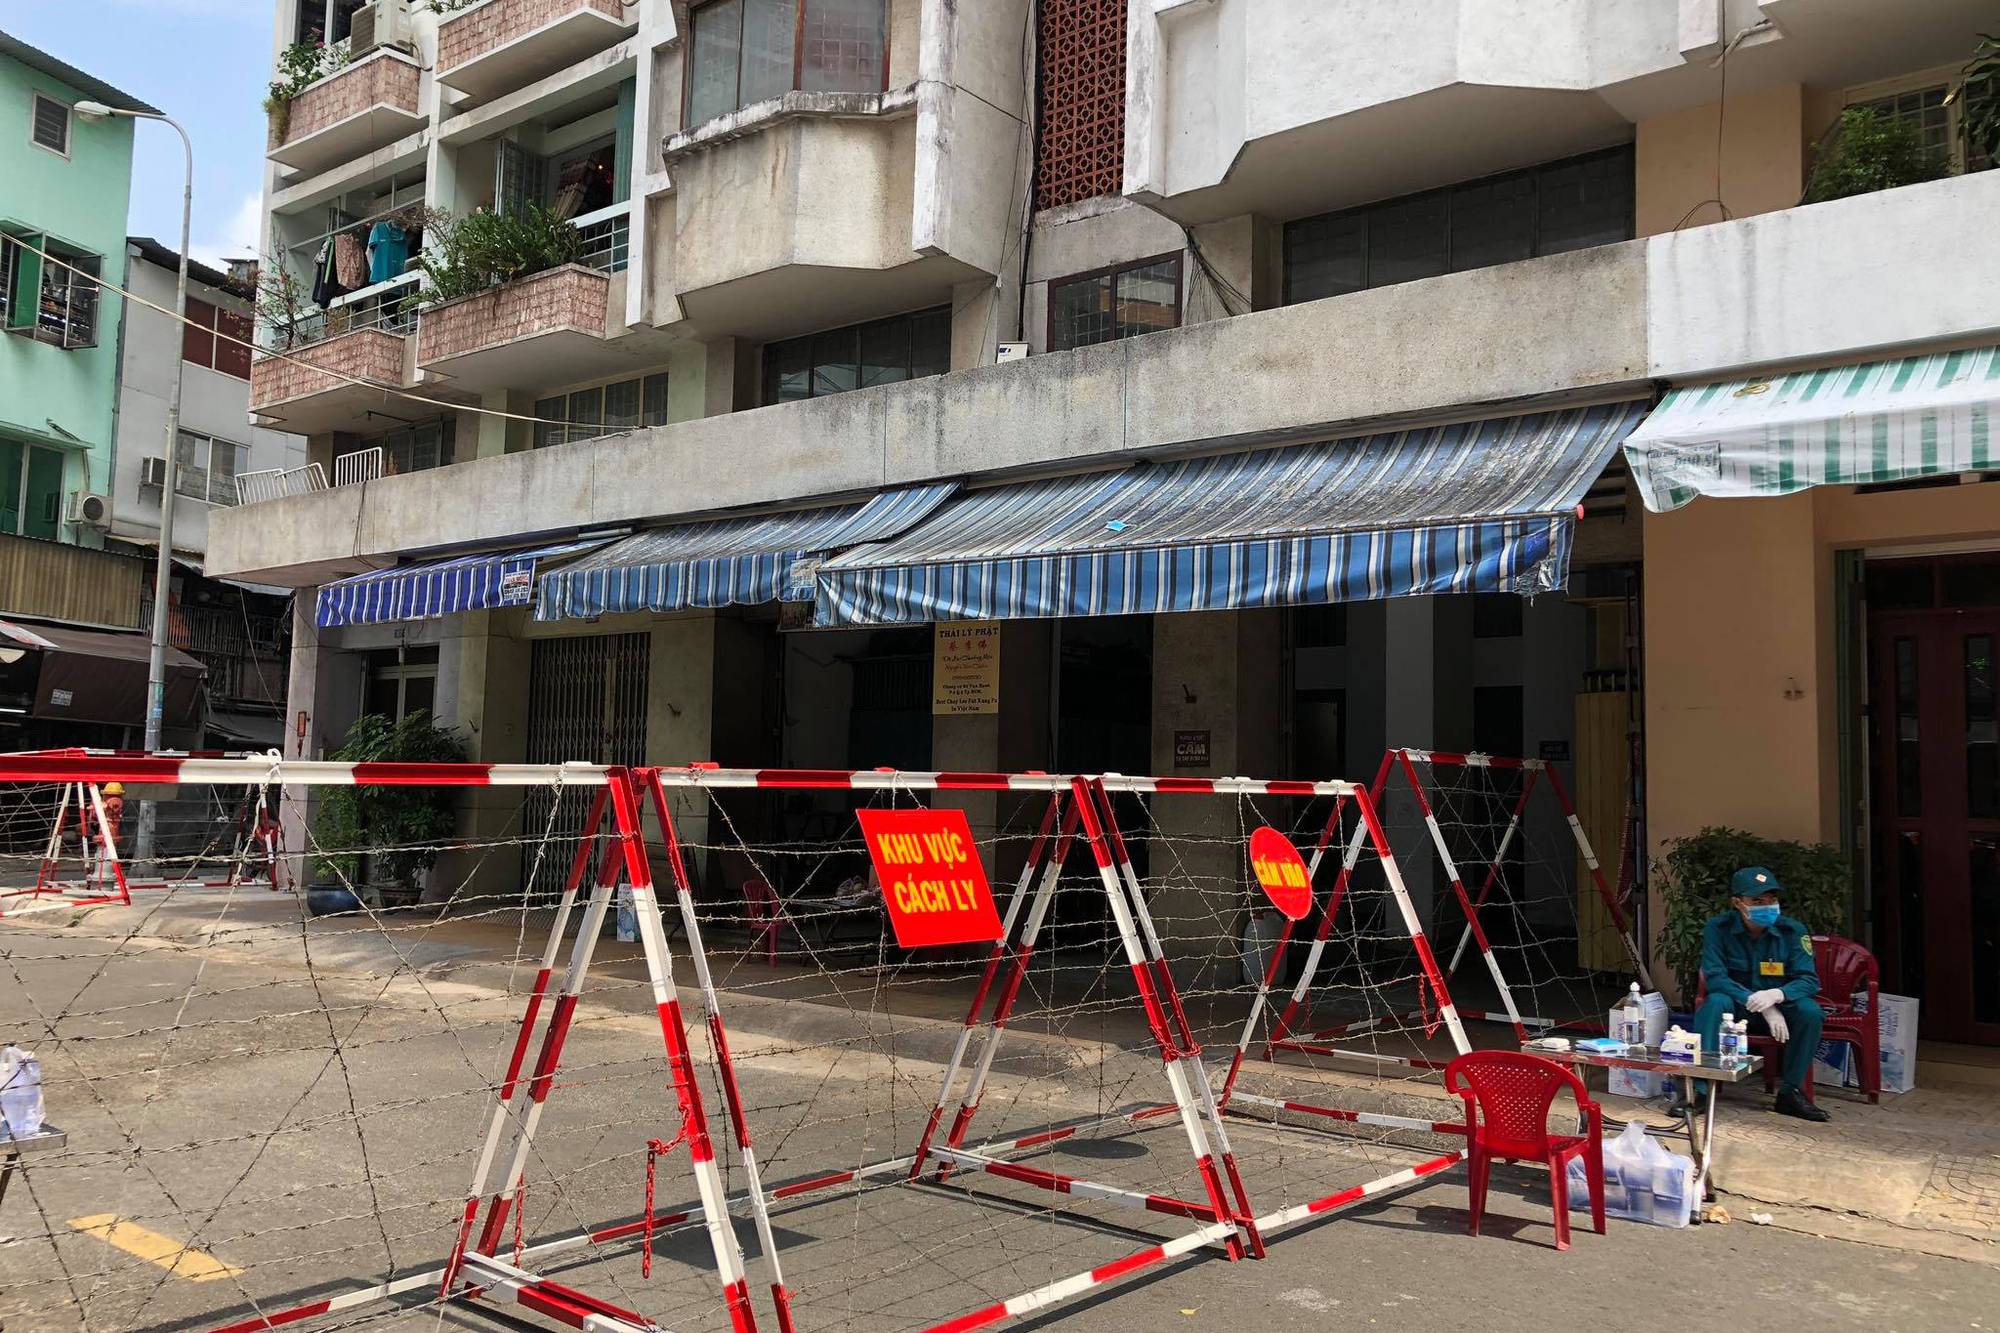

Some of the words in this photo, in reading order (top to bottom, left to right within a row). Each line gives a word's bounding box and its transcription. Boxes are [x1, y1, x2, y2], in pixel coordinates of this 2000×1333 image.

[1177, 741, 1206, 755] CẤM
[876, 833, 924, 865] KHU
[923, 827, 968, 870] VỰC
[894, 873, 951, 914] CÁCH
[950, 879, 978, 911] LY
